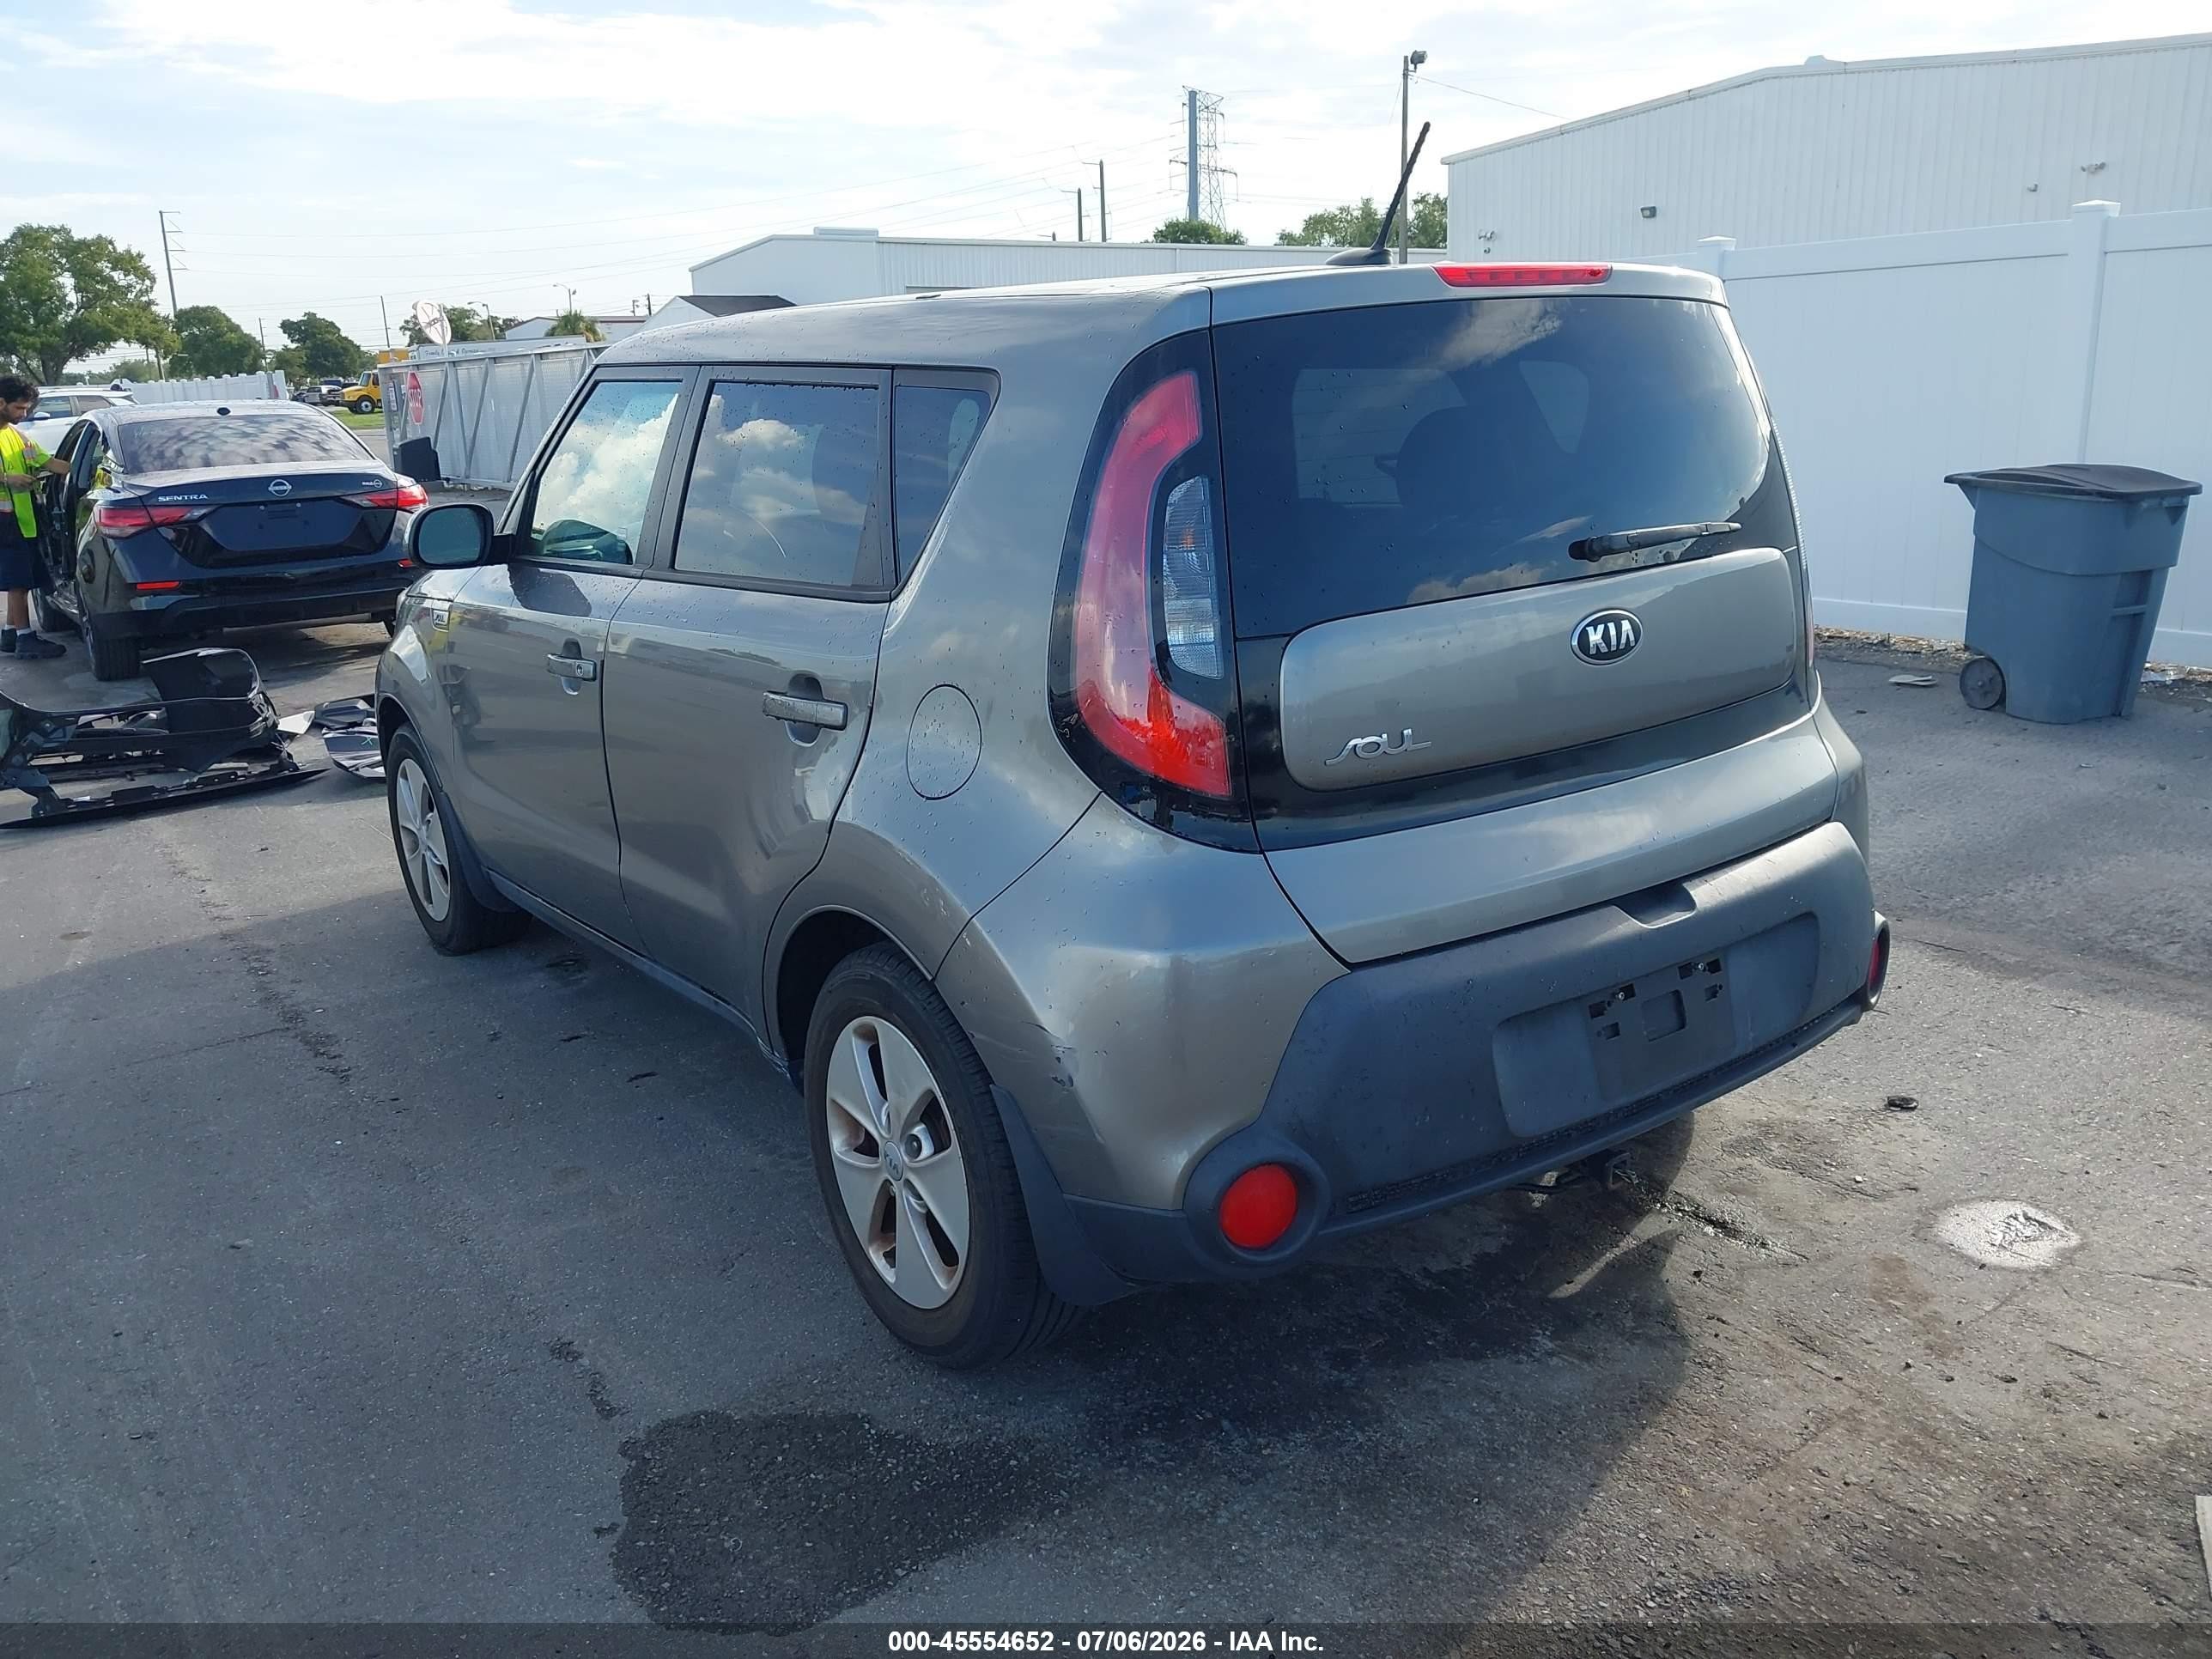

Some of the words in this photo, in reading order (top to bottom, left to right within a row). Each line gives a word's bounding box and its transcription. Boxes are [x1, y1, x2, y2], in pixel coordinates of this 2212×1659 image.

[408, 388, 422, 407] STOP
[1586, 619, 1636, 655] KIA
[1324, 728, 1432, 765] SOUL
